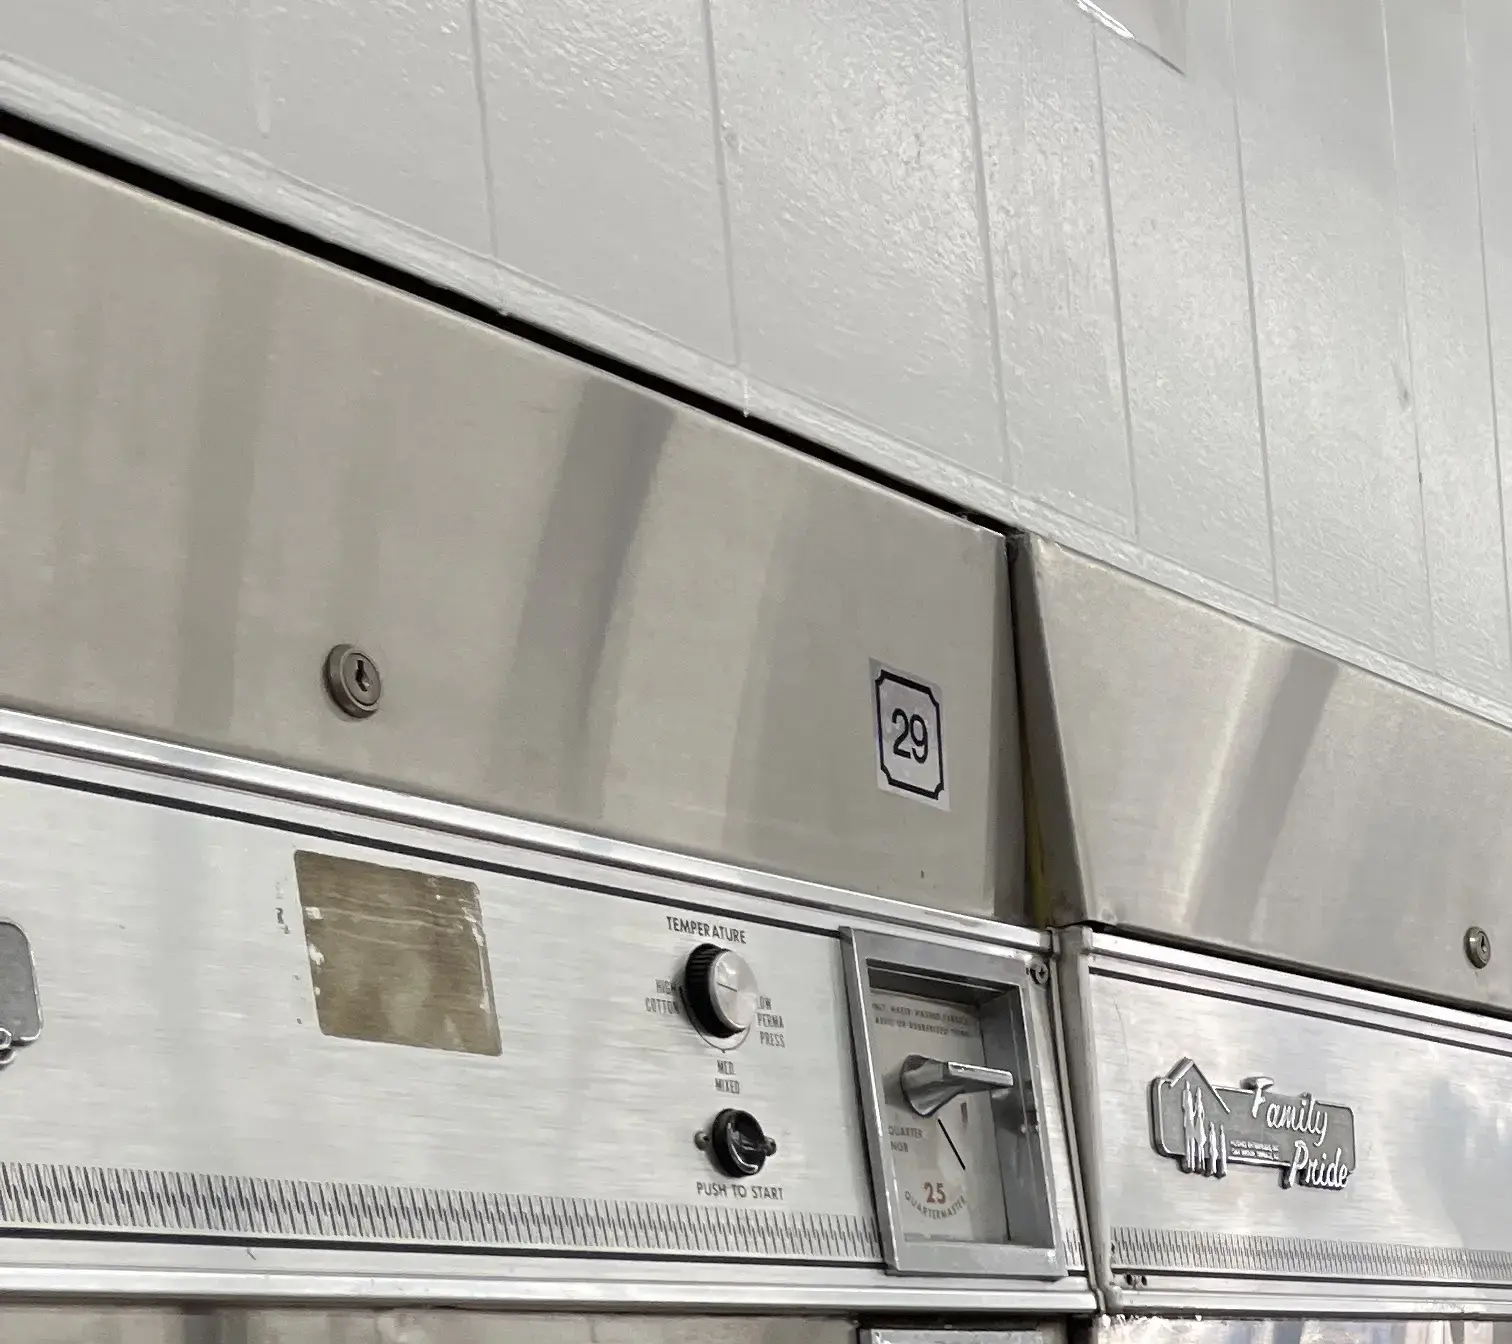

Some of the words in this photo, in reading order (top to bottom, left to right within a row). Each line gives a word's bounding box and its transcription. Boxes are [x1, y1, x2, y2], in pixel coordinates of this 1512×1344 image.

[892, 708, 929, 764] 29
[666, 916, 746, 944] TEMPERATURE
[645, 997, 681, 1015] COTTON
[757, 1013, 784, 1028] PERMA
[760, 1031, 785, 1048] PRESS
[715, 1078, 740, 1094] MIXED
[1240, 1076, 1328, 1147] Family
[888, 1125, 923, 1139] QUARTER
[1290, 1140, 1349, 1188] Pride
[697, 1181, 728, 1198] PUSH
[732, 1184, 747, 1198] TO
[751, 1186, 784, 1200] START
[924, 1182, 946, 1204] 25
[905, 1191, 966, 1219] QUARTERMASTER
